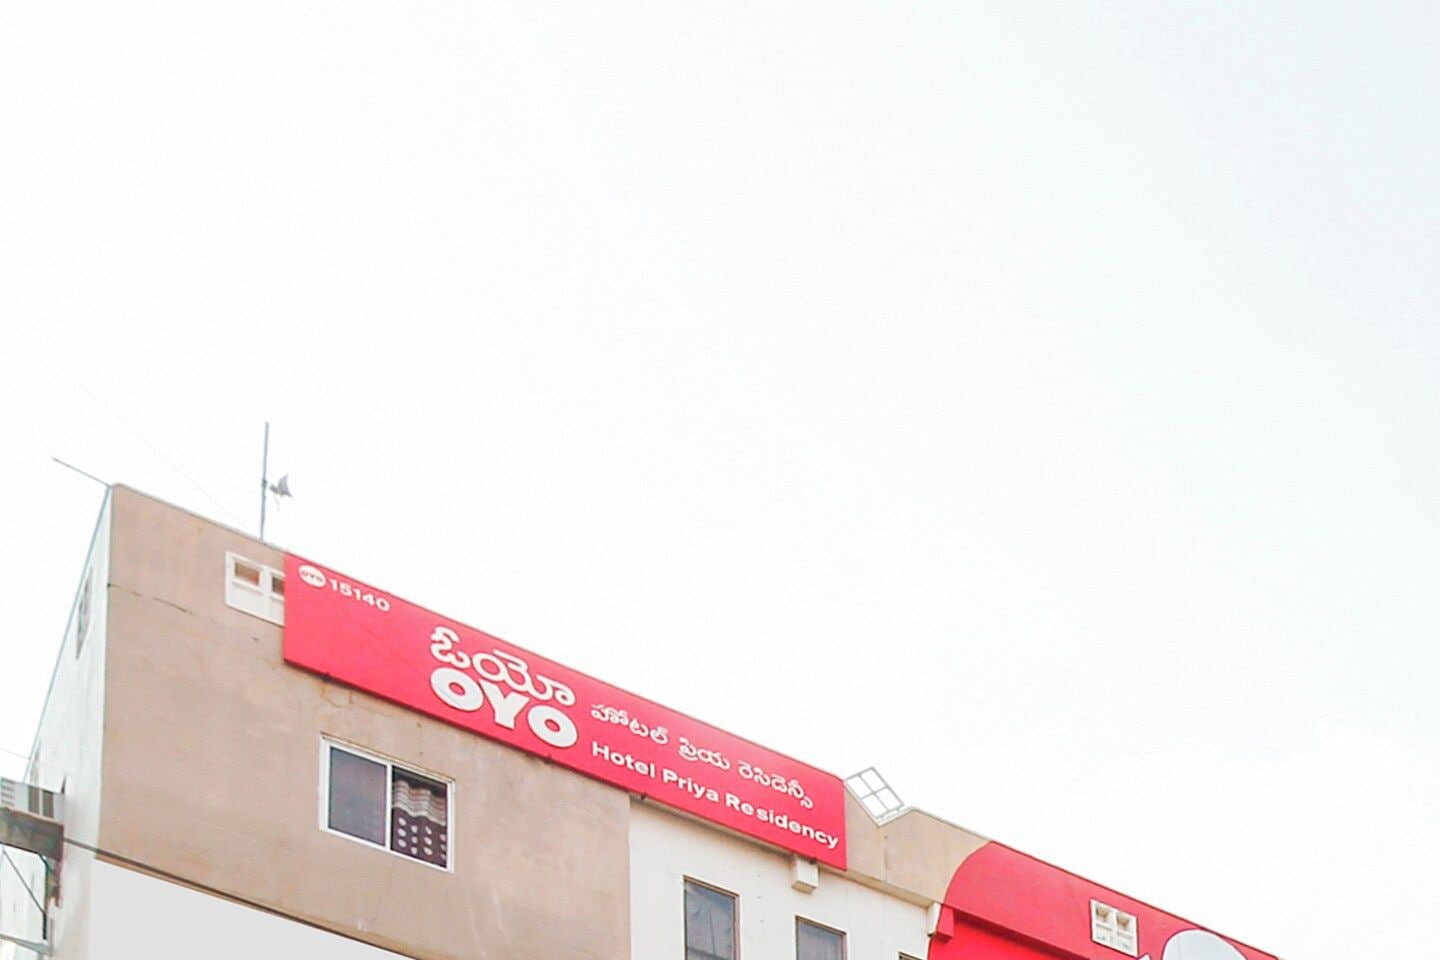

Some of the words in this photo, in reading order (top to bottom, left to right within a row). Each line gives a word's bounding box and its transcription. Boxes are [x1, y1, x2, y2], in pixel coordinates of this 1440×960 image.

[330, 578, 391, 612] 15140
[430, 666, 580, 748] OYO
[592, 741, 656, 778] Hotel
[663, 767, 720, 803] Priya
[725, 792, 839, 850] Residency
